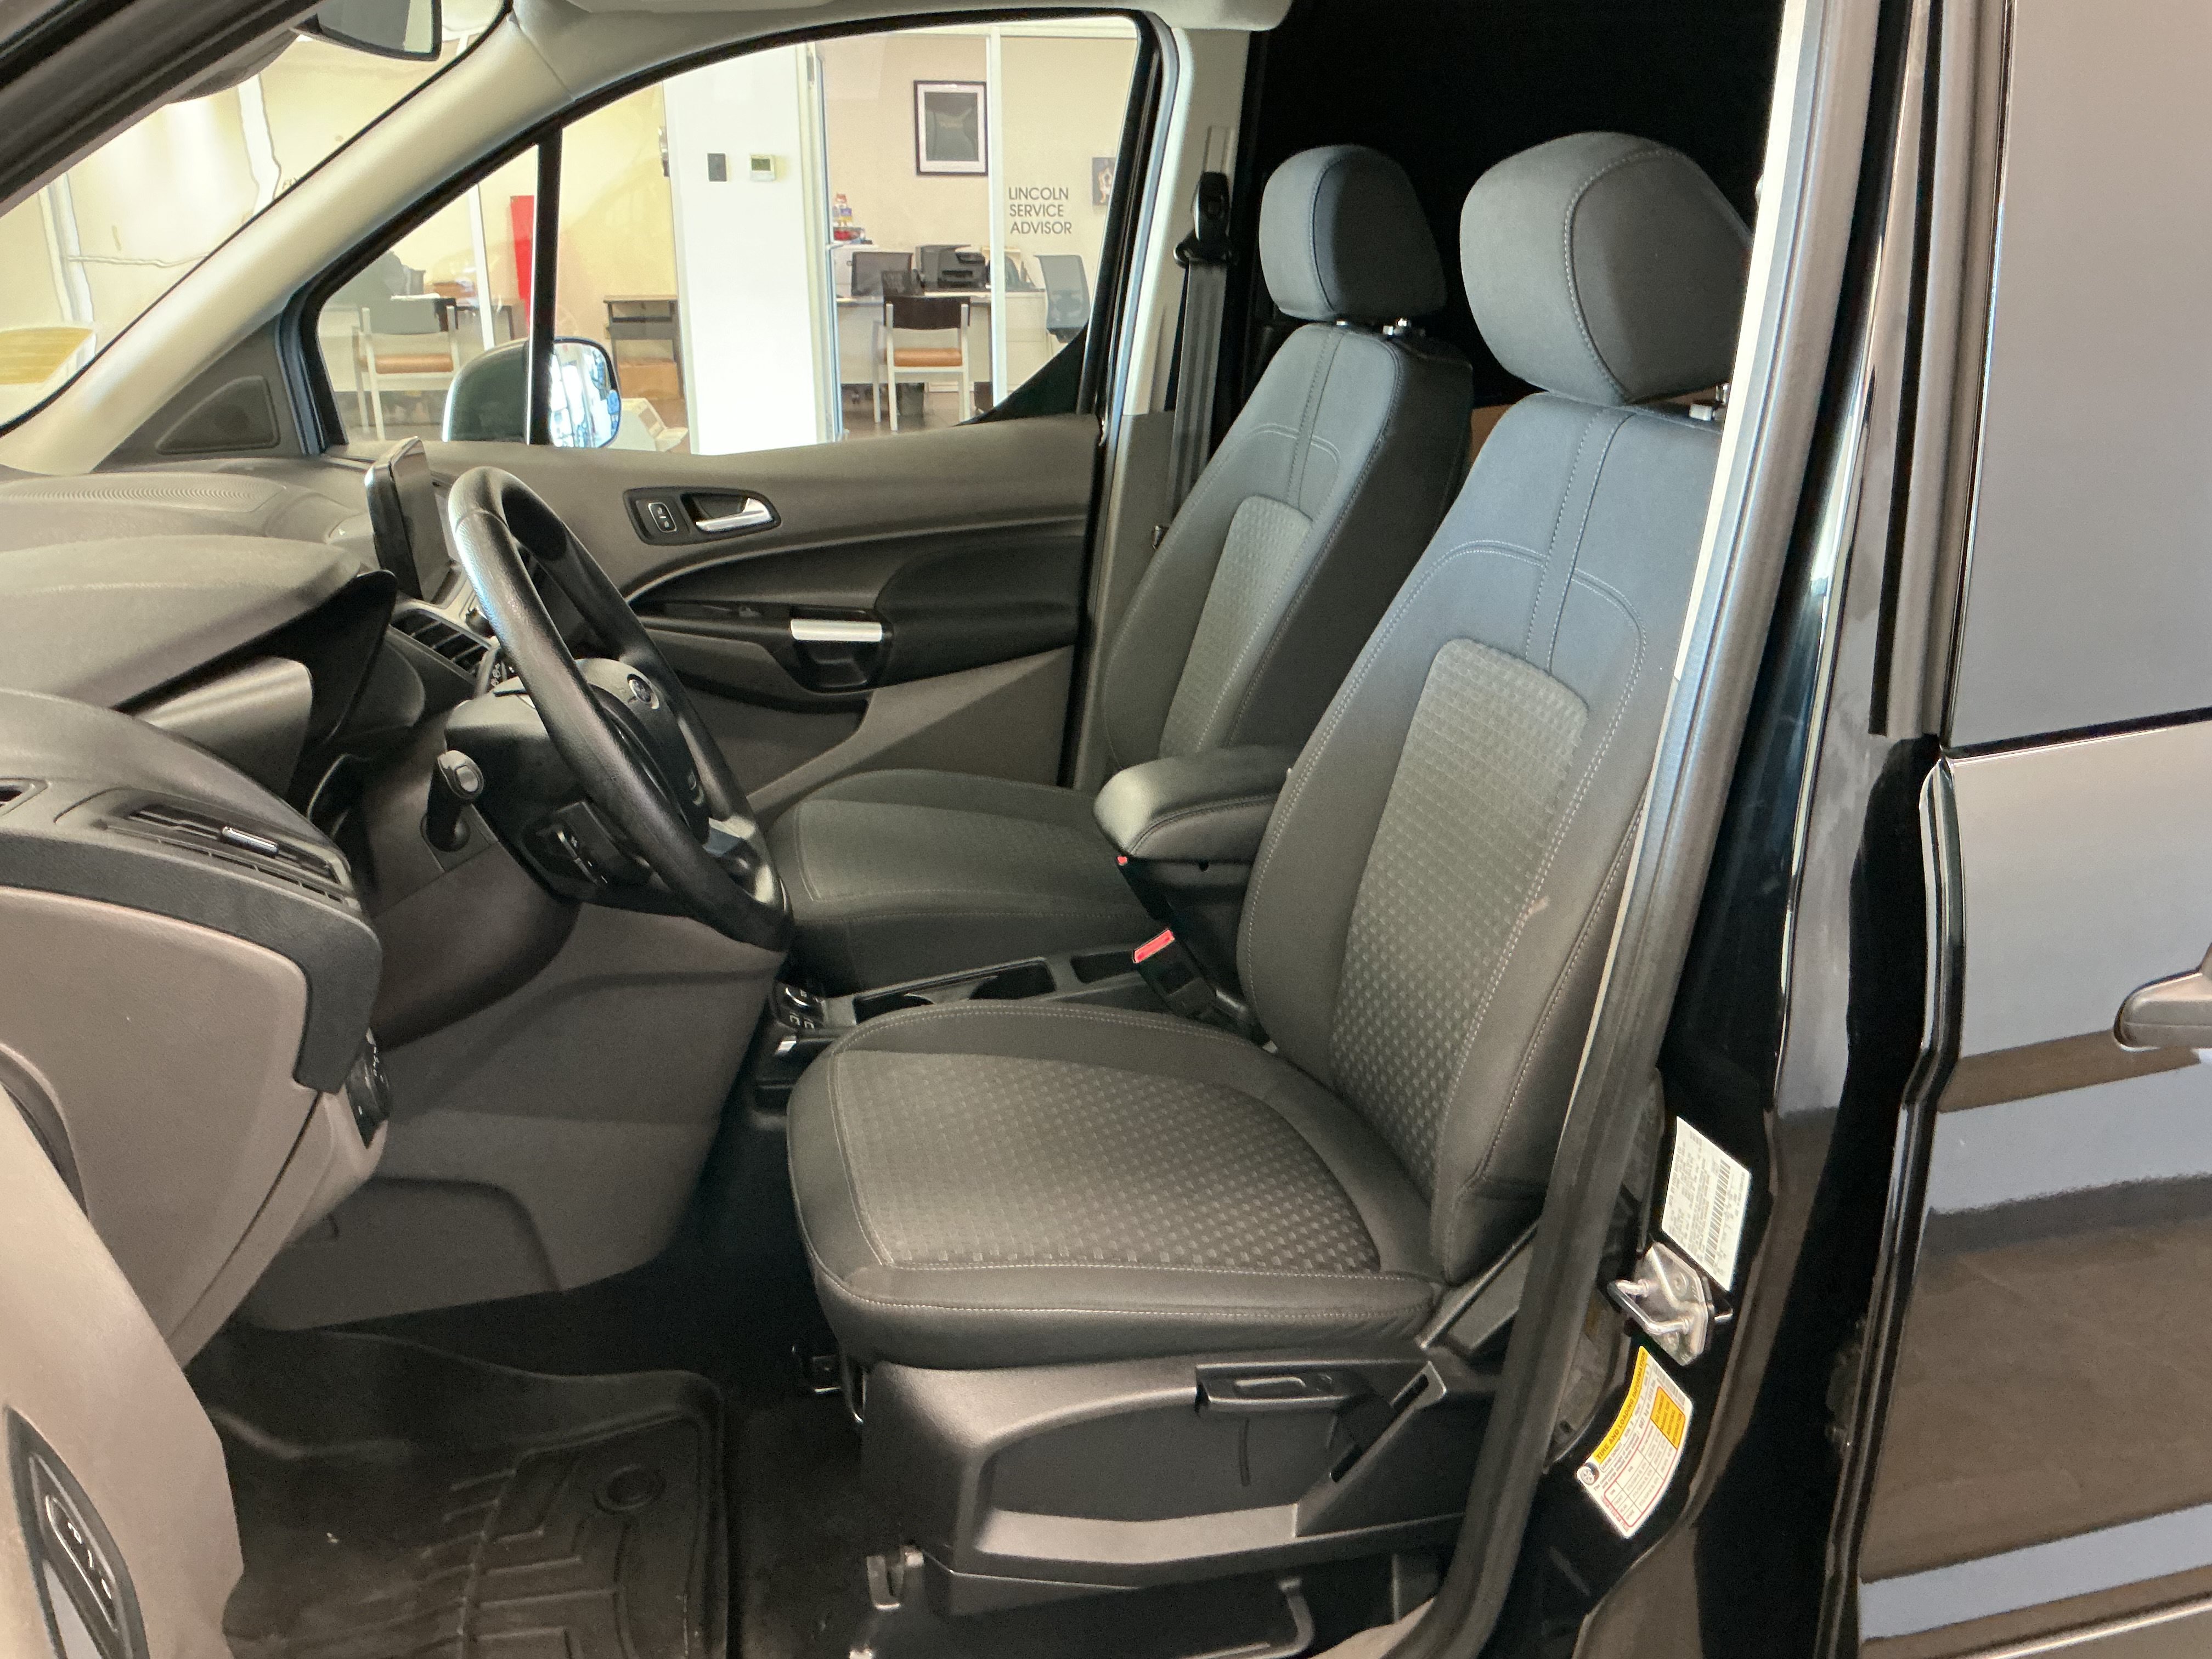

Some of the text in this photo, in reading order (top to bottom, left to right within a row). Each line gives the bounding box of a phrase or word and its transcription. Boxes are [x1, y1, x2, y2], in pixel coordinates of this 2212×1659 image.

[1009, 187, 1069, 200] LINCOLN
[1009, 204, 1064, 217] SERVICE
[1010, 221, 1073, 234] ADVISOR
[1595, 1349, 1645, 1460] TIRE AND LOADING INFORMATION
